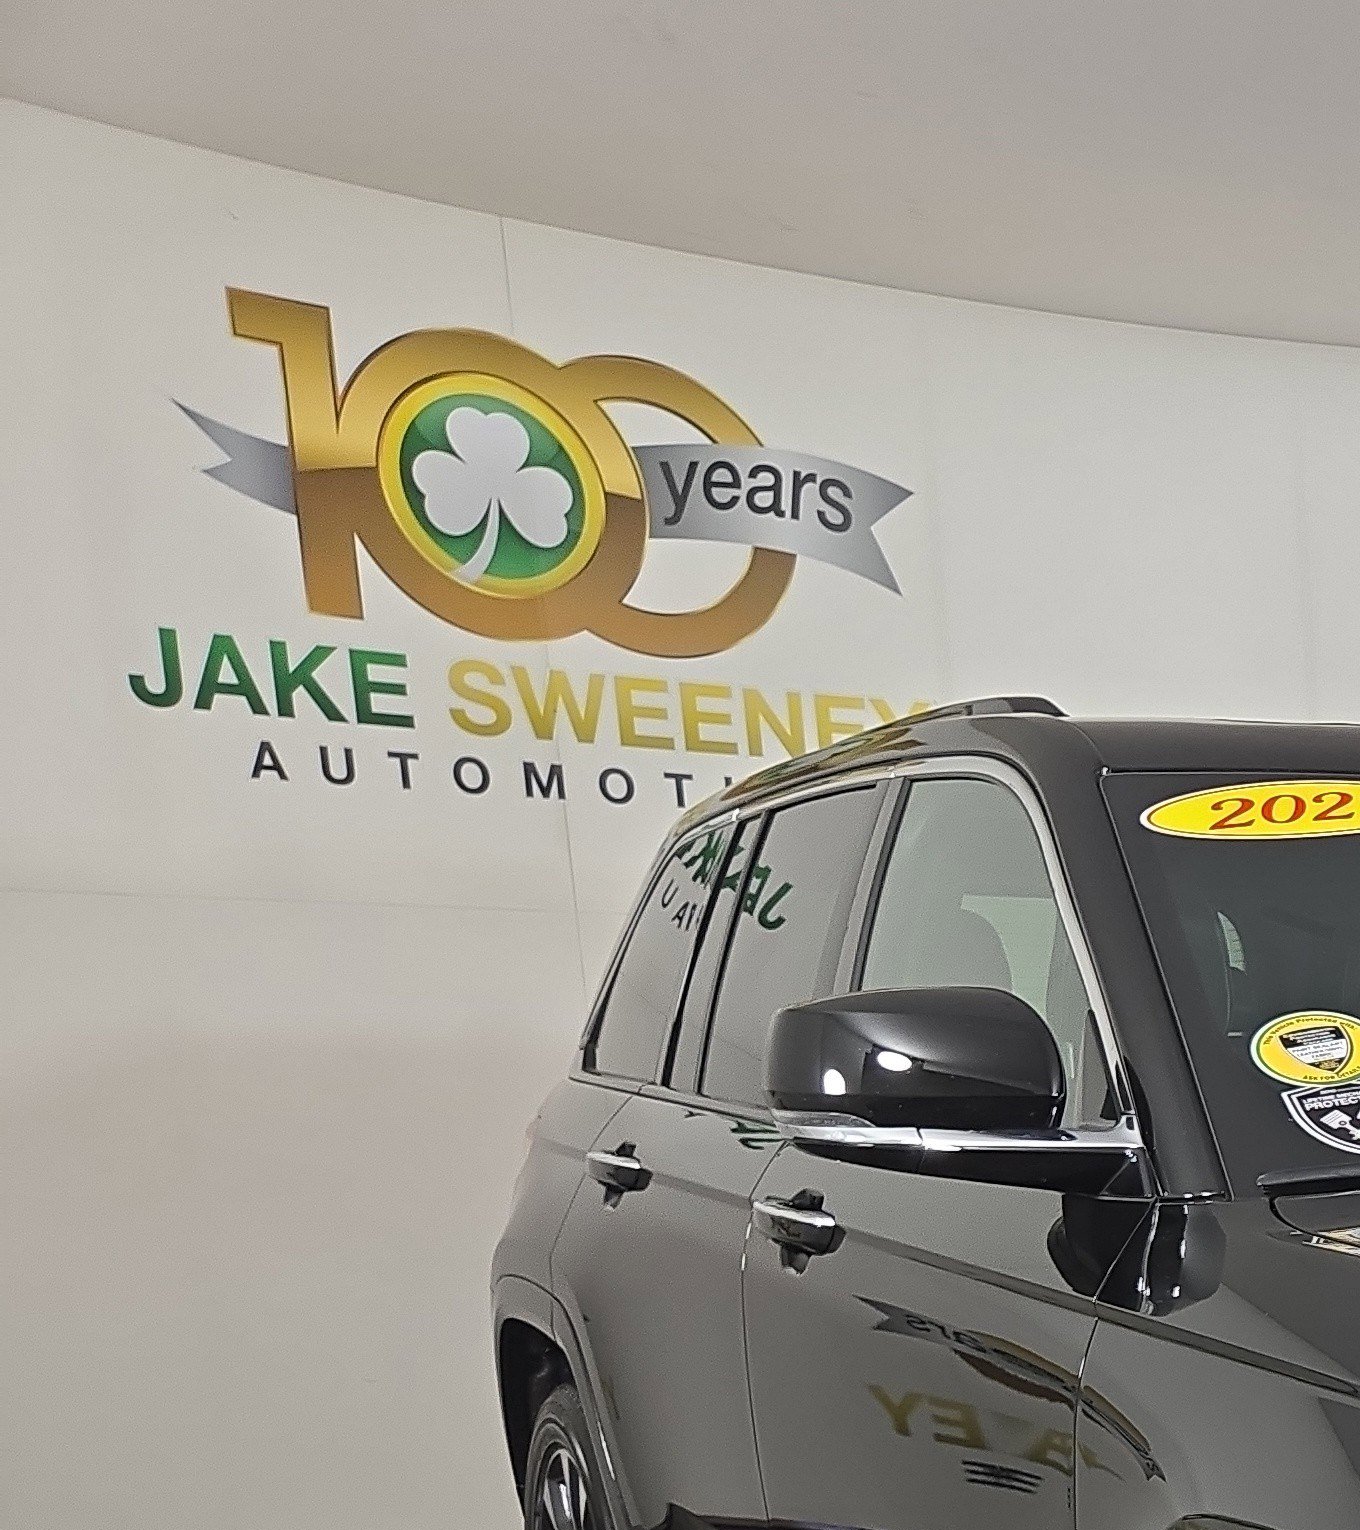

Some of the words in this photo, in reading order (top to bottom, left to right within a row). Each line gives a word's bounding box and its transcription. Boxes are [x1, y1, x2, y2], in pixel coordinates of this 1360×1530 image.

[660, 454, 854, 533] years
[127, 627, 414, 731] JAKE
[251, 741, 733, 810] AUTOMOT
